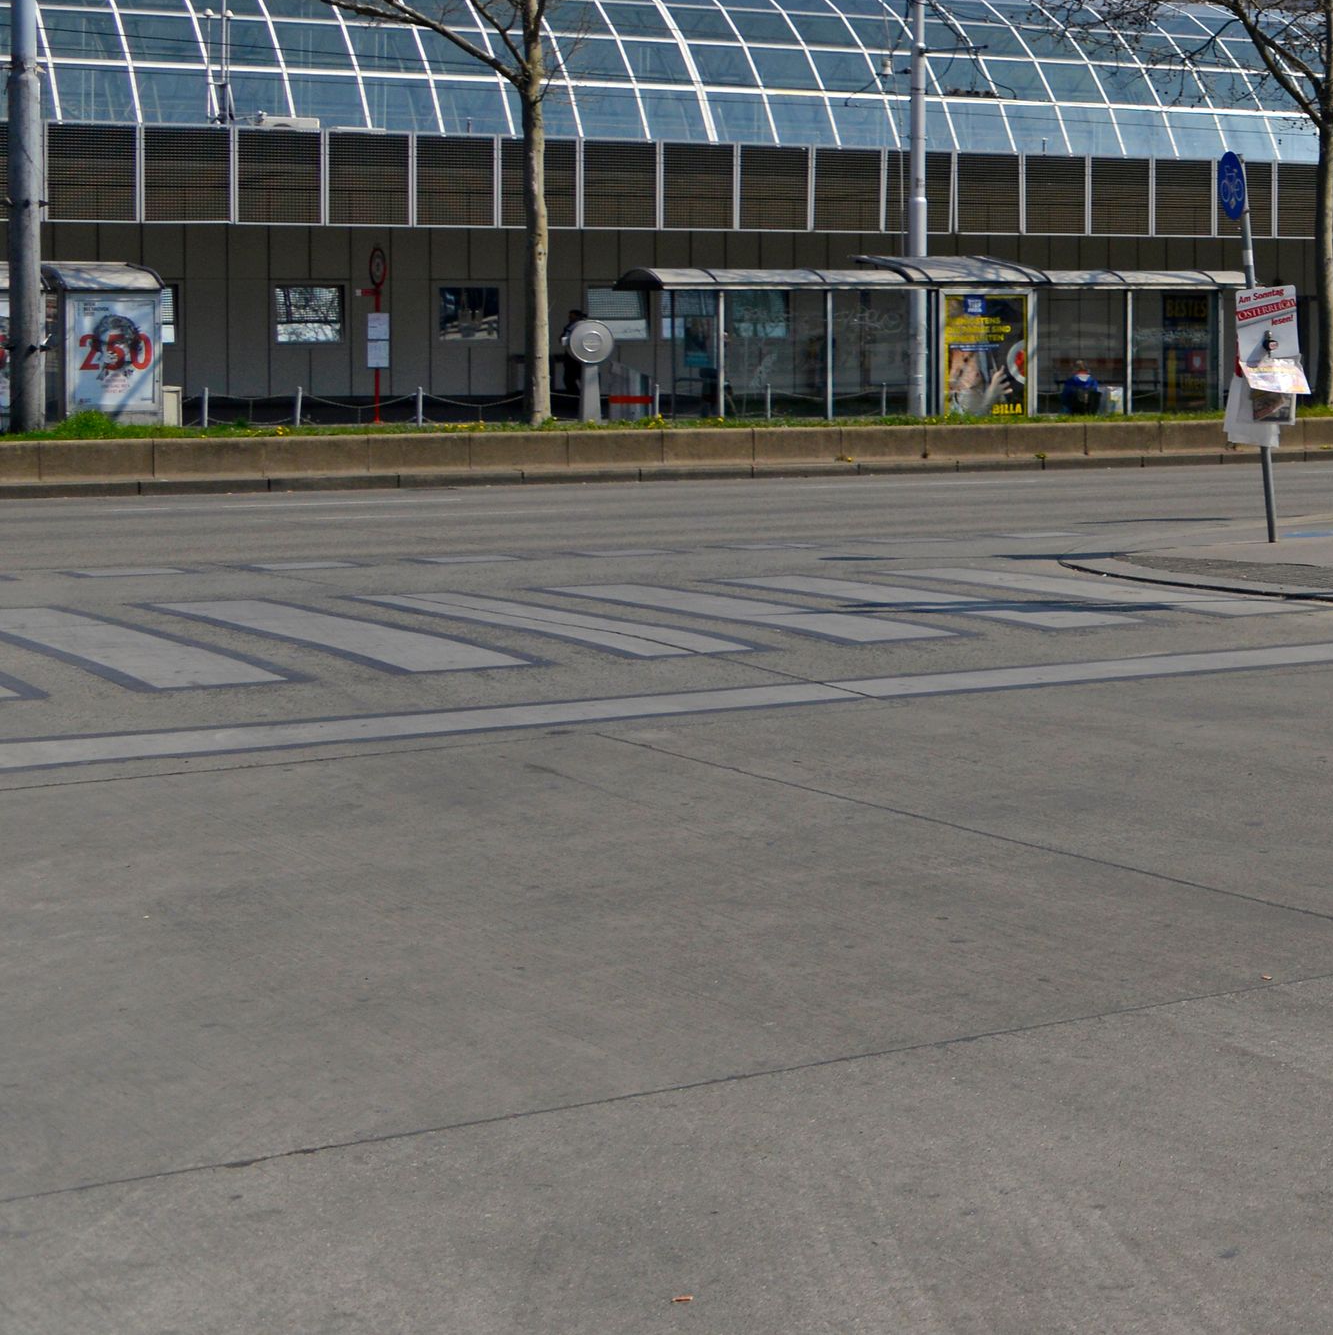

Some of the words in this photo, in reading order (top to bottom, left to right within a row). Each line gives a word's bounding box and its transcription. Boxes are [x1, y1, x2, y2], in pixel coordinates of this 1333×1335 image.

[1238, 295, 1251, 304] Am
[1252, 288, 1284, 301] Sonntag
[1271, 313, 1294, 326] lesen!
[79, 332, 153, 371] 250
[992, 403, 1022, 415] BILLA
